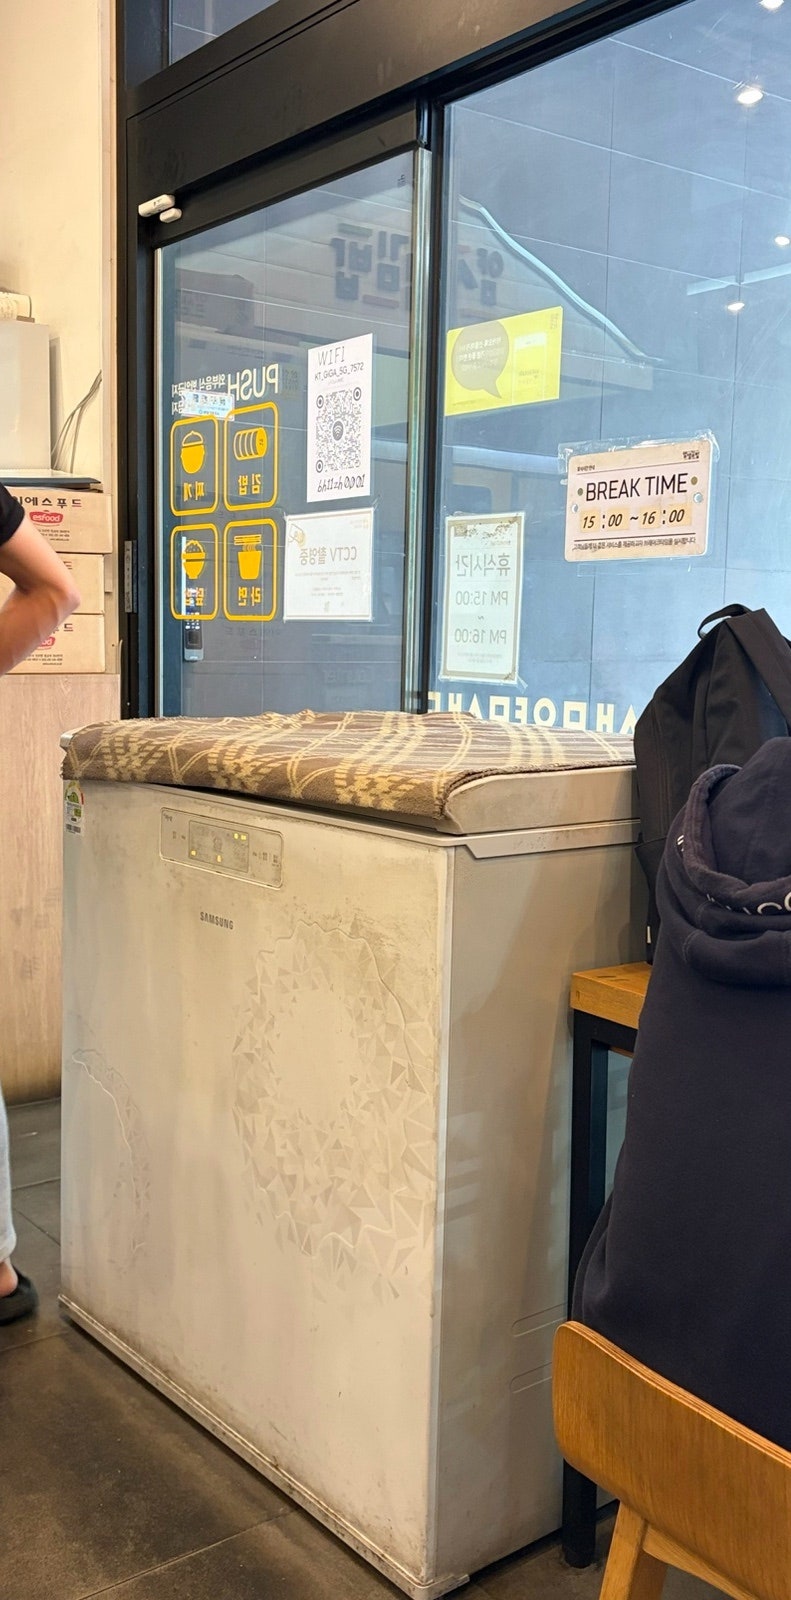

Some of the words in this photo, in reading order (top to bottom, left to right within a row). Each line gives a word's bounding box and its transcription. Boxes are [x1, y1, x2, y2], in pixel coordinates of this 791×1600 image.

[318, 346, 345, 366] WIFI
[586, 478, 640, 502] BREAK
[645, 473, 688, 496] TIME
[32, 513, 61, 522] esfood
[200, 911, 234, 930] SAMSUNG
